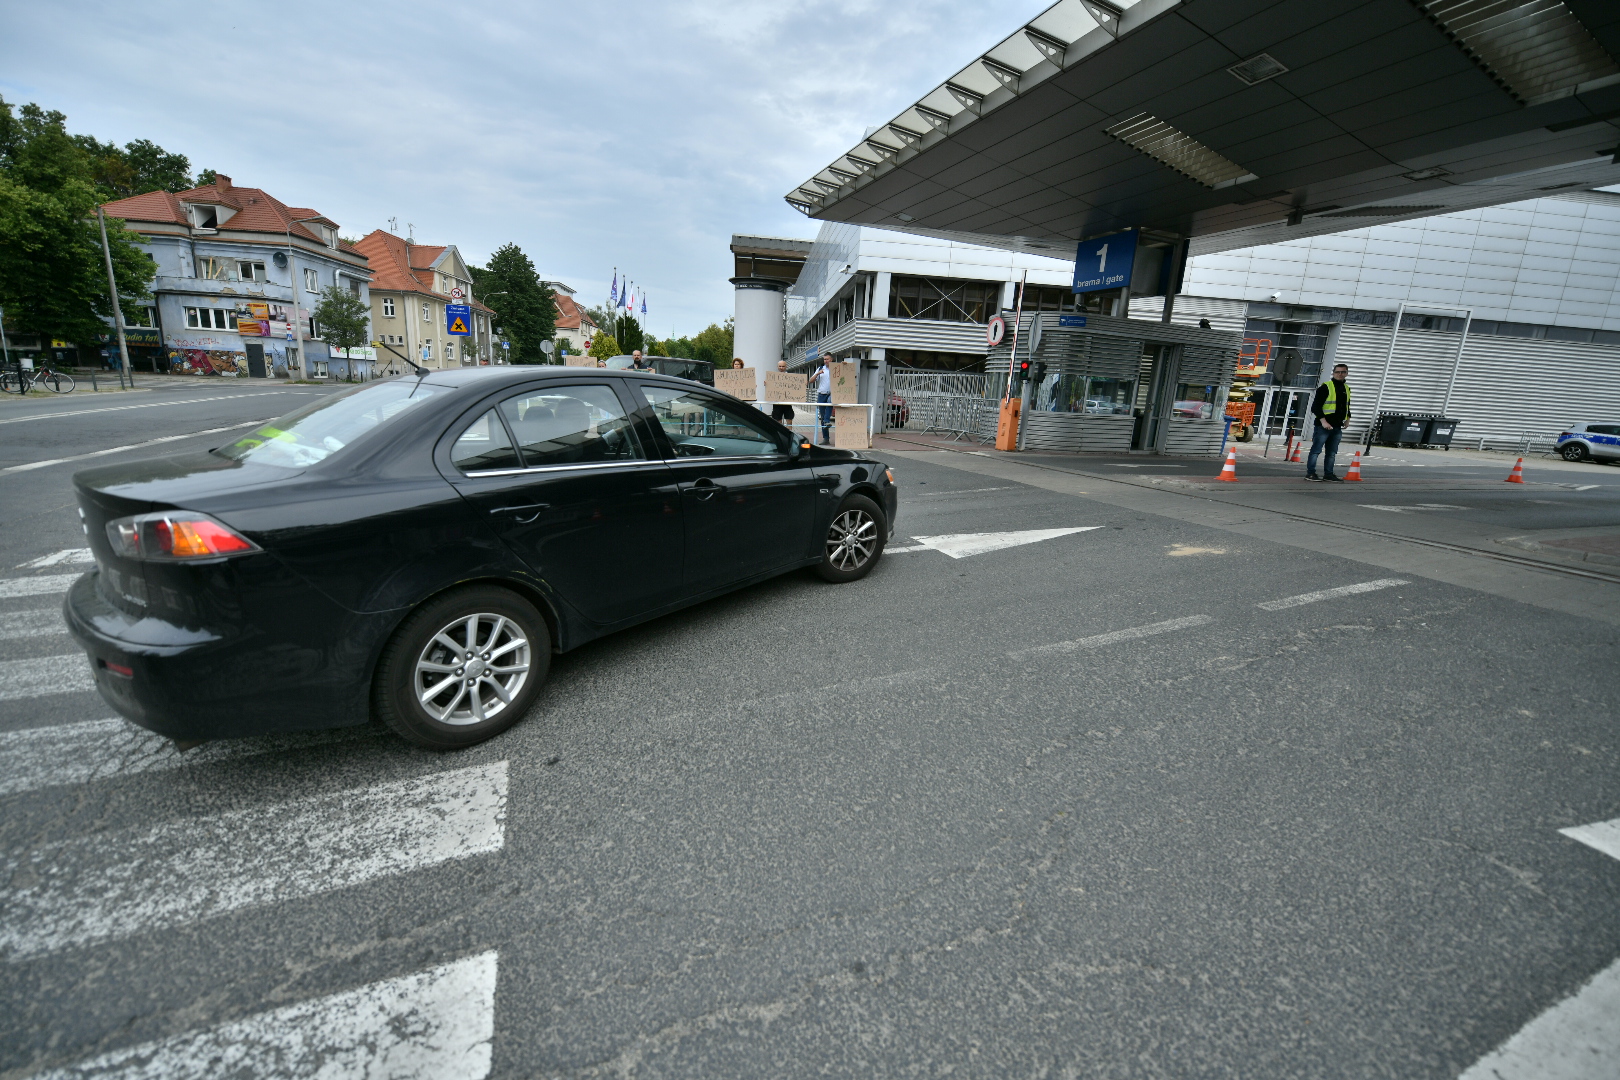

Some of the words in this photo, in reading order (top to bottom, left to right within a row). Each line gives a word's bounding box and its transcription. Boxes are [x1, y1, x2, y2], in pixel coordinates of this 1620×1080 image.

[1097, 244, 1108, 273] 1
[1077, 280, 1101, 288] brama
[1106, 275, 1124, 285] gate
